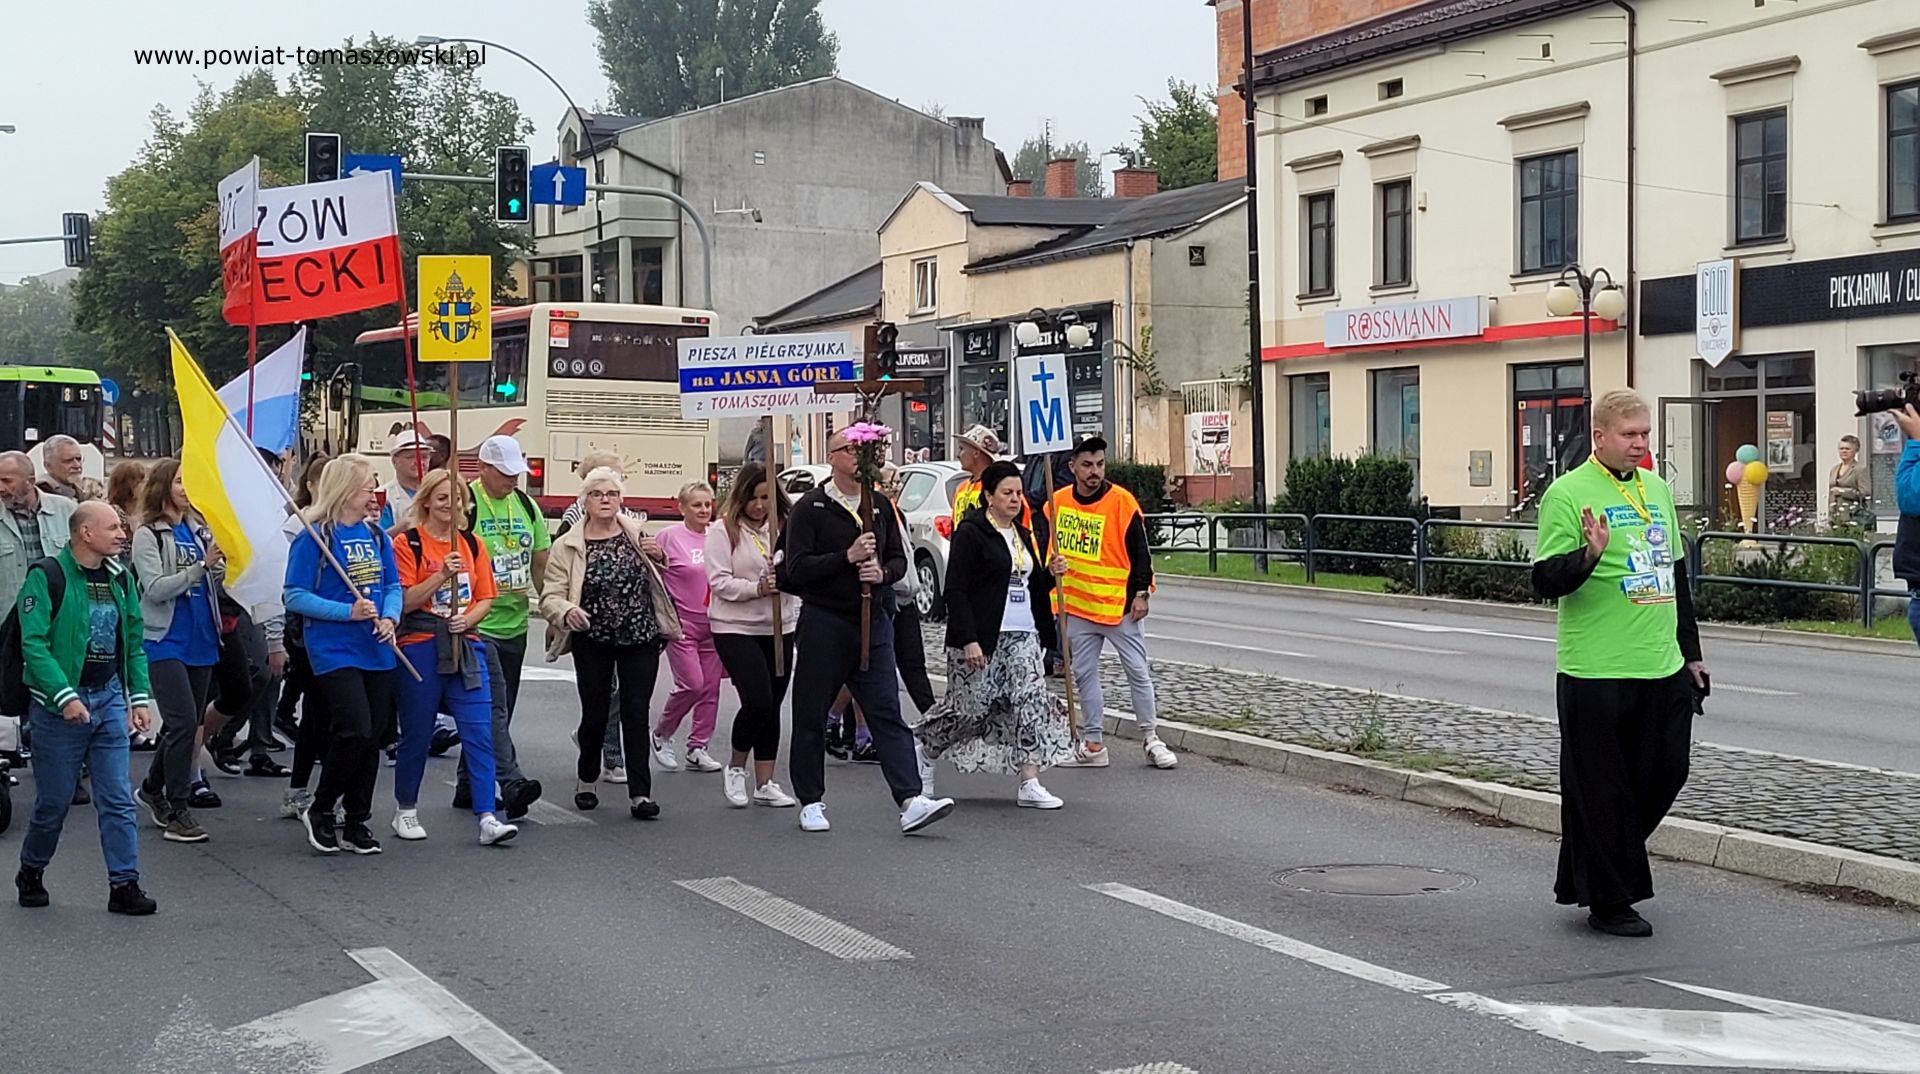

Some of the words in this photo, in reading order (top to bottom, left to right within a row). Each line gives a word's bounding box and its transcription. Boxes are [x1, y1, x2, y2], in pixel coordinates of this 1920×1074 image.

[1829, 270, 1891, 310] PIEKARNIA
[1347, 303, 1452, 342] ROSSMANN
[687, 347, 737, 362] PIESZA
[745, 341, 846, 360] PIELGRZYMKA
[692, 376, 714, 387] na
[719, 369, 782, 388] JASNĄ
[79, 389, 88, 401] 15
[711, 393, 800, 411] TOMASZOWA
[1029, 397, 1064, 444] M
[1058, 512, 1102, 536] KIEROWANIE
[343, 543, 376, 562] 205
[1057, 530, 1100, 557] RUCHEM
